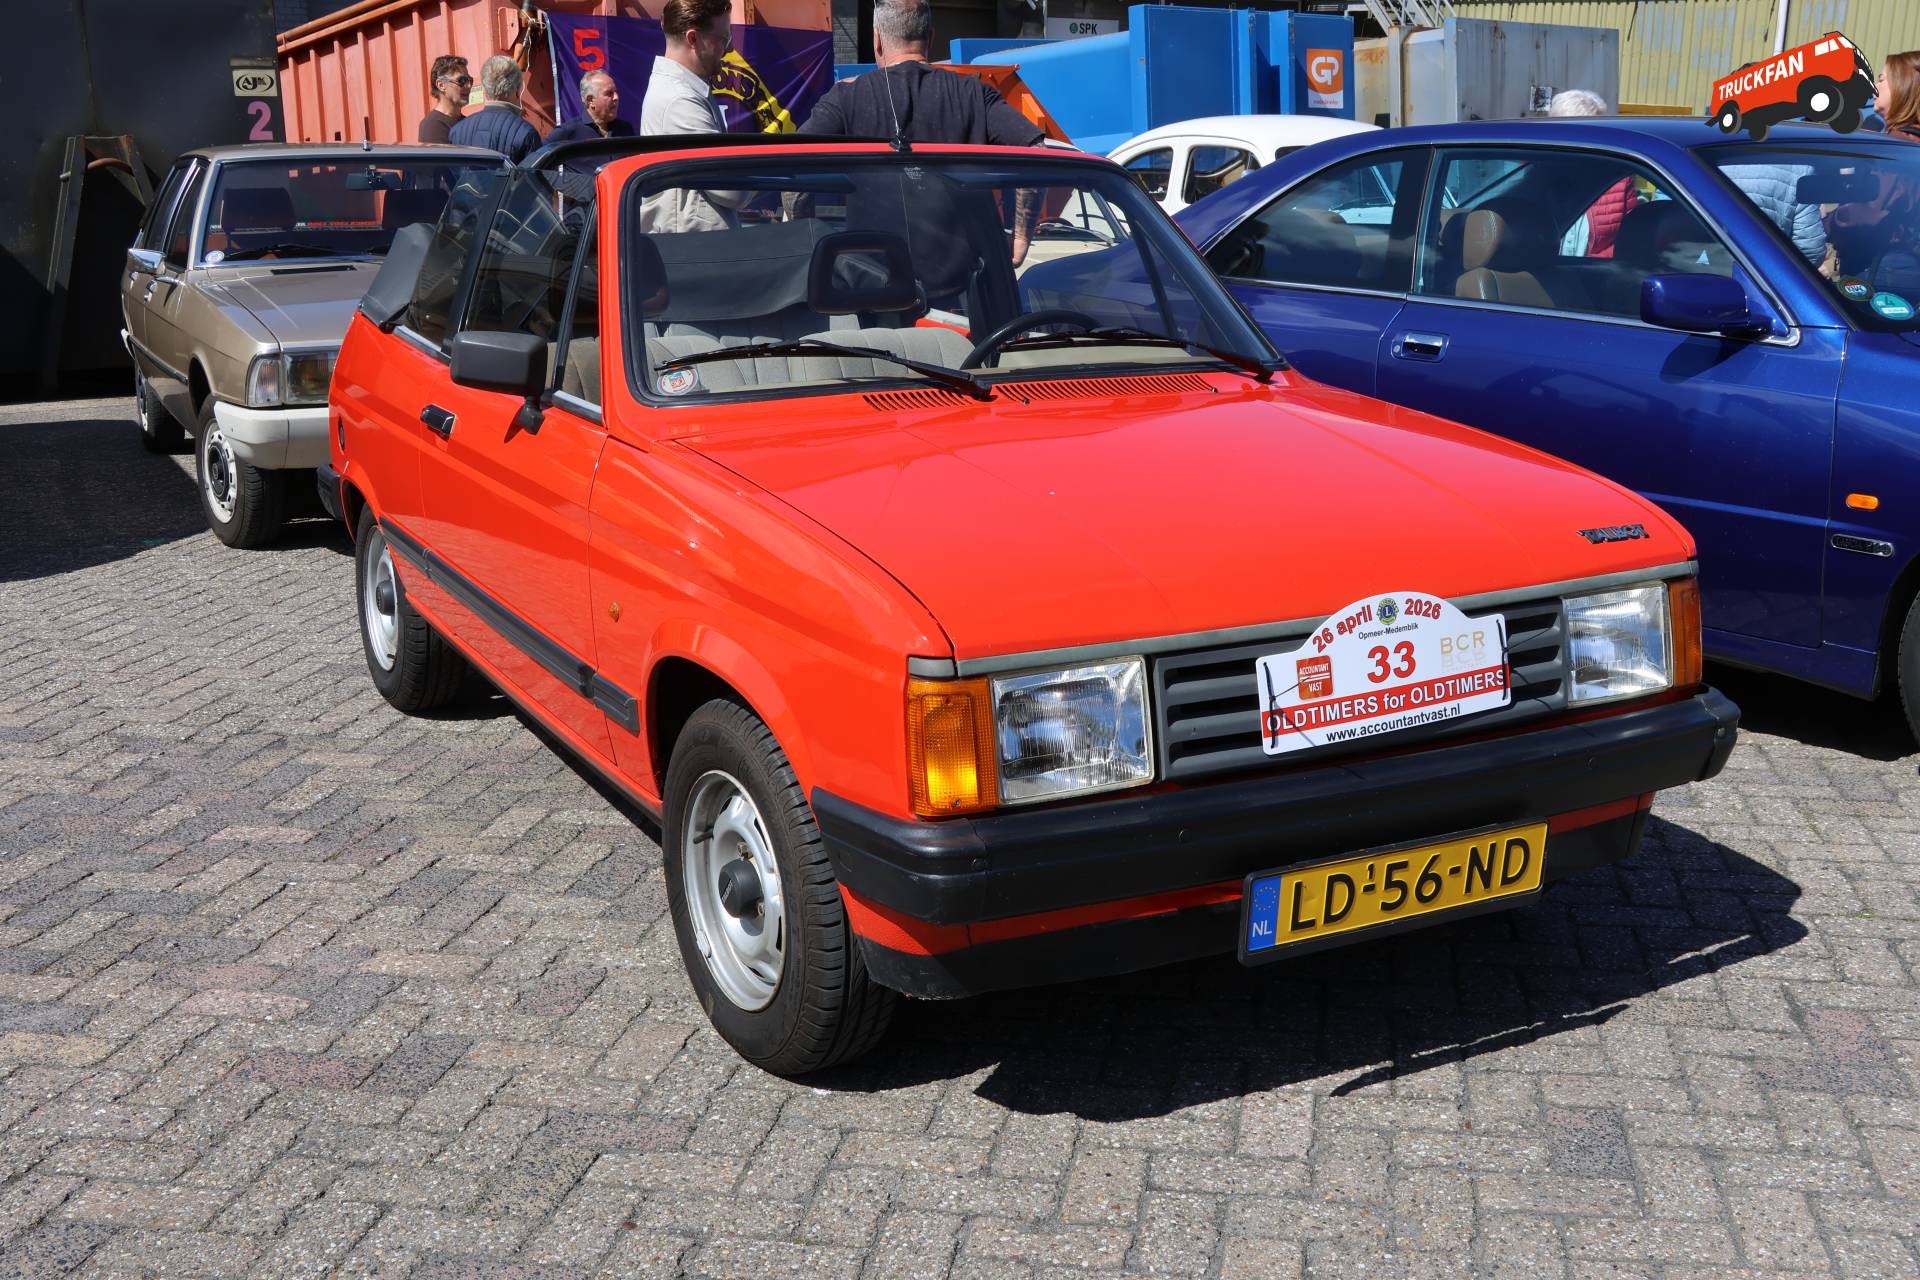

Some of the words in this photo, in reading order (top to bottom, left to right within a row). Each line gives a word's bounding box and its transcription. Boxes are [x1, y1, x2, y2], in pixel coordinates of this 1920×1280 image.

[1079, 23, 1097, 35] SPK
[573, 29, 605, 71] 5
[247, 101, 273, 141] 2
[1312, 627, 1335, 654] 26
[1336, 604, 1373, 634] april
[1404, 598, 1442, 620] 2026
[1358, 622, 1419, 640] Opmeer-Medemblik
[1440, 631, 1485, 656] BCR
[1299, 663, 1329, 675] ACCOUNTANT
[1367, 640, 1416, 684] 33
[1266, 697, 1379, 732] OLDTIMERS
[1383, 691, 1406, 709] for
[1410, 669, 1505, 703] OLDTIMERS
[1309, 682, 1322, 693] VAST
[1326, 703, 1461, 743] www.accountantvast.nl
[1251, 919, 1273, 938] NL
